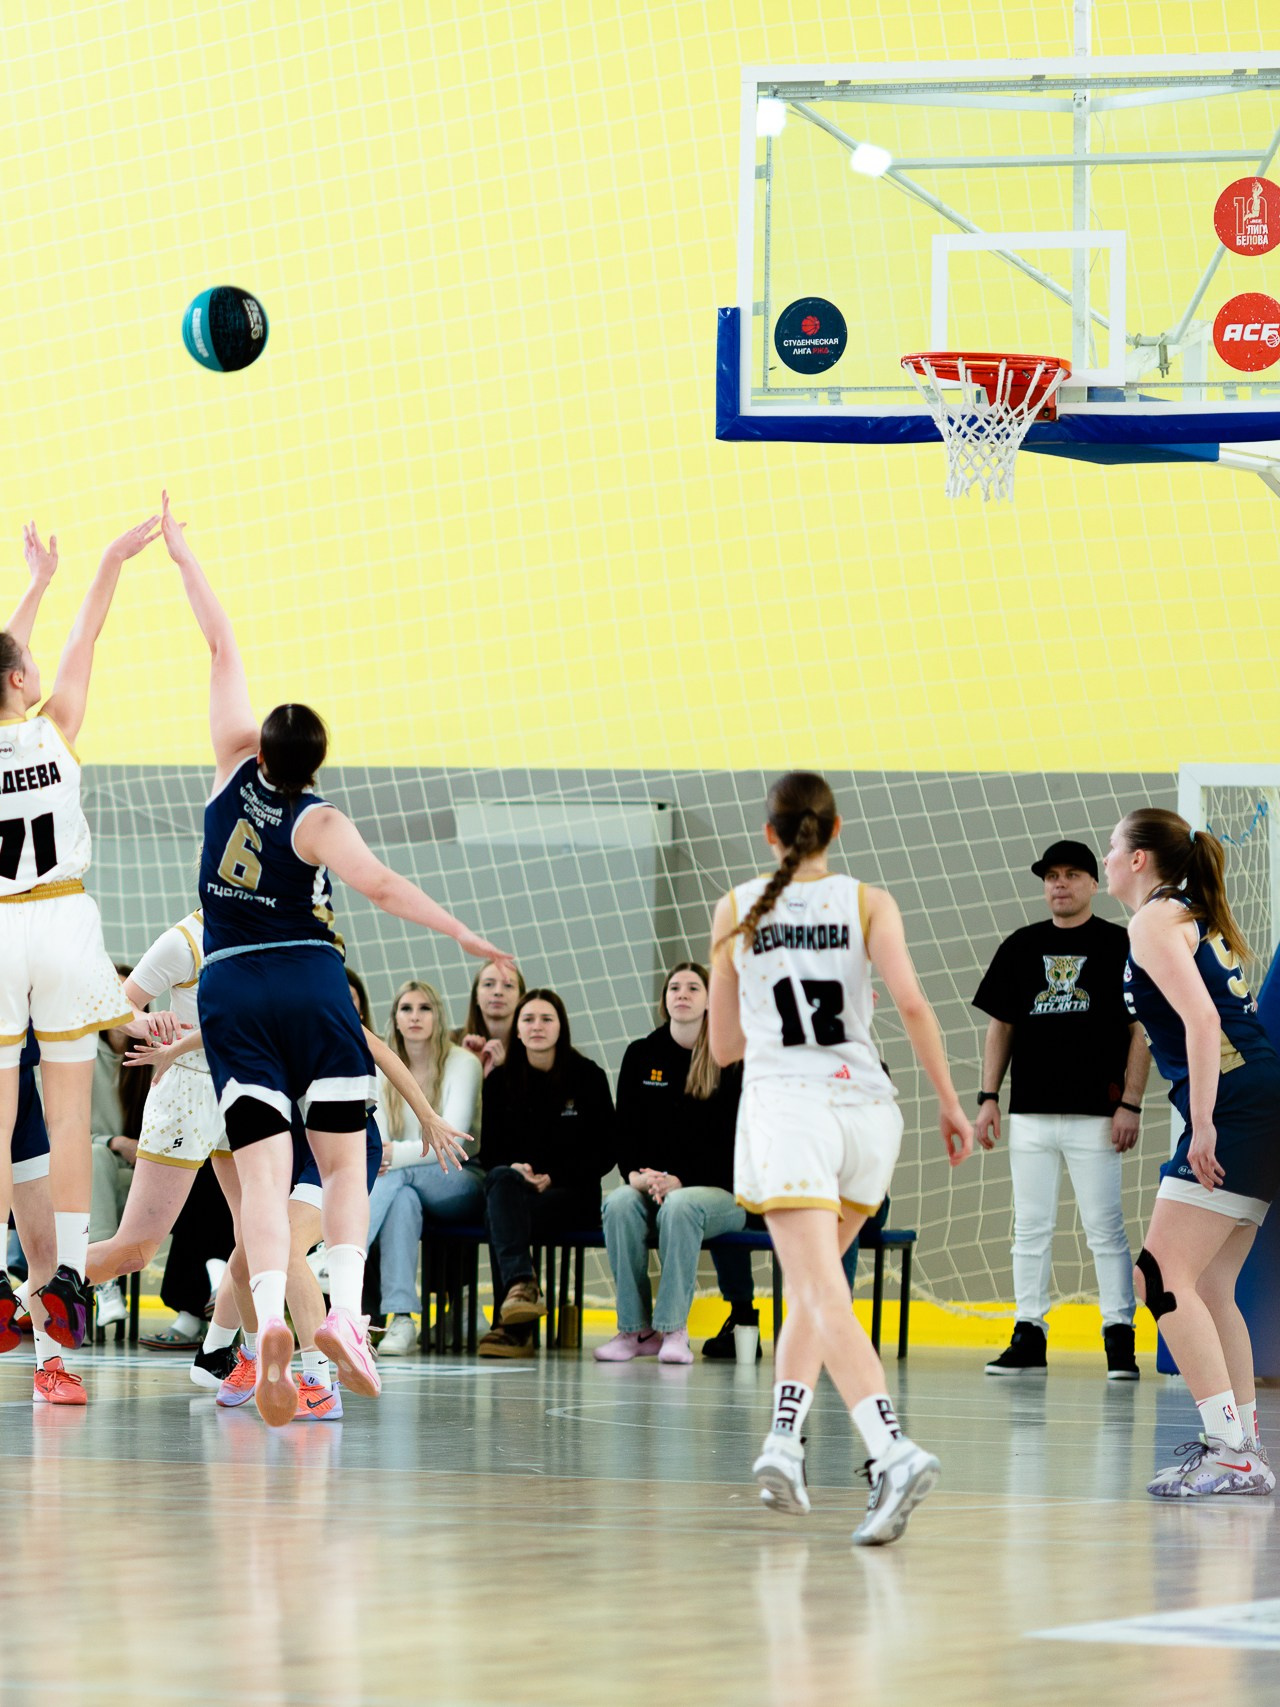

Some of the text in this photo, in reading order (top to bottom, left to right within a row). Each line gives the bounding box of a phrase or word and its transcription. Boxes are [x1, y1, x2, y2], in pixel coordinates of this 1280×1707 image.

[1247, 224, 1268, 235] ЛИГА
[1236, 235, 1268, 246] БЕЛОВА
[1222, 323, 1280, 342] АСБ
[783, 338, 839, 347] СТУДЕНЧЕСКАЯ
[217, 818, 262, 891] 6
[773, 976, 846, 1047] 12
[1035, 1001, 1087, 1013] ATLANTA
